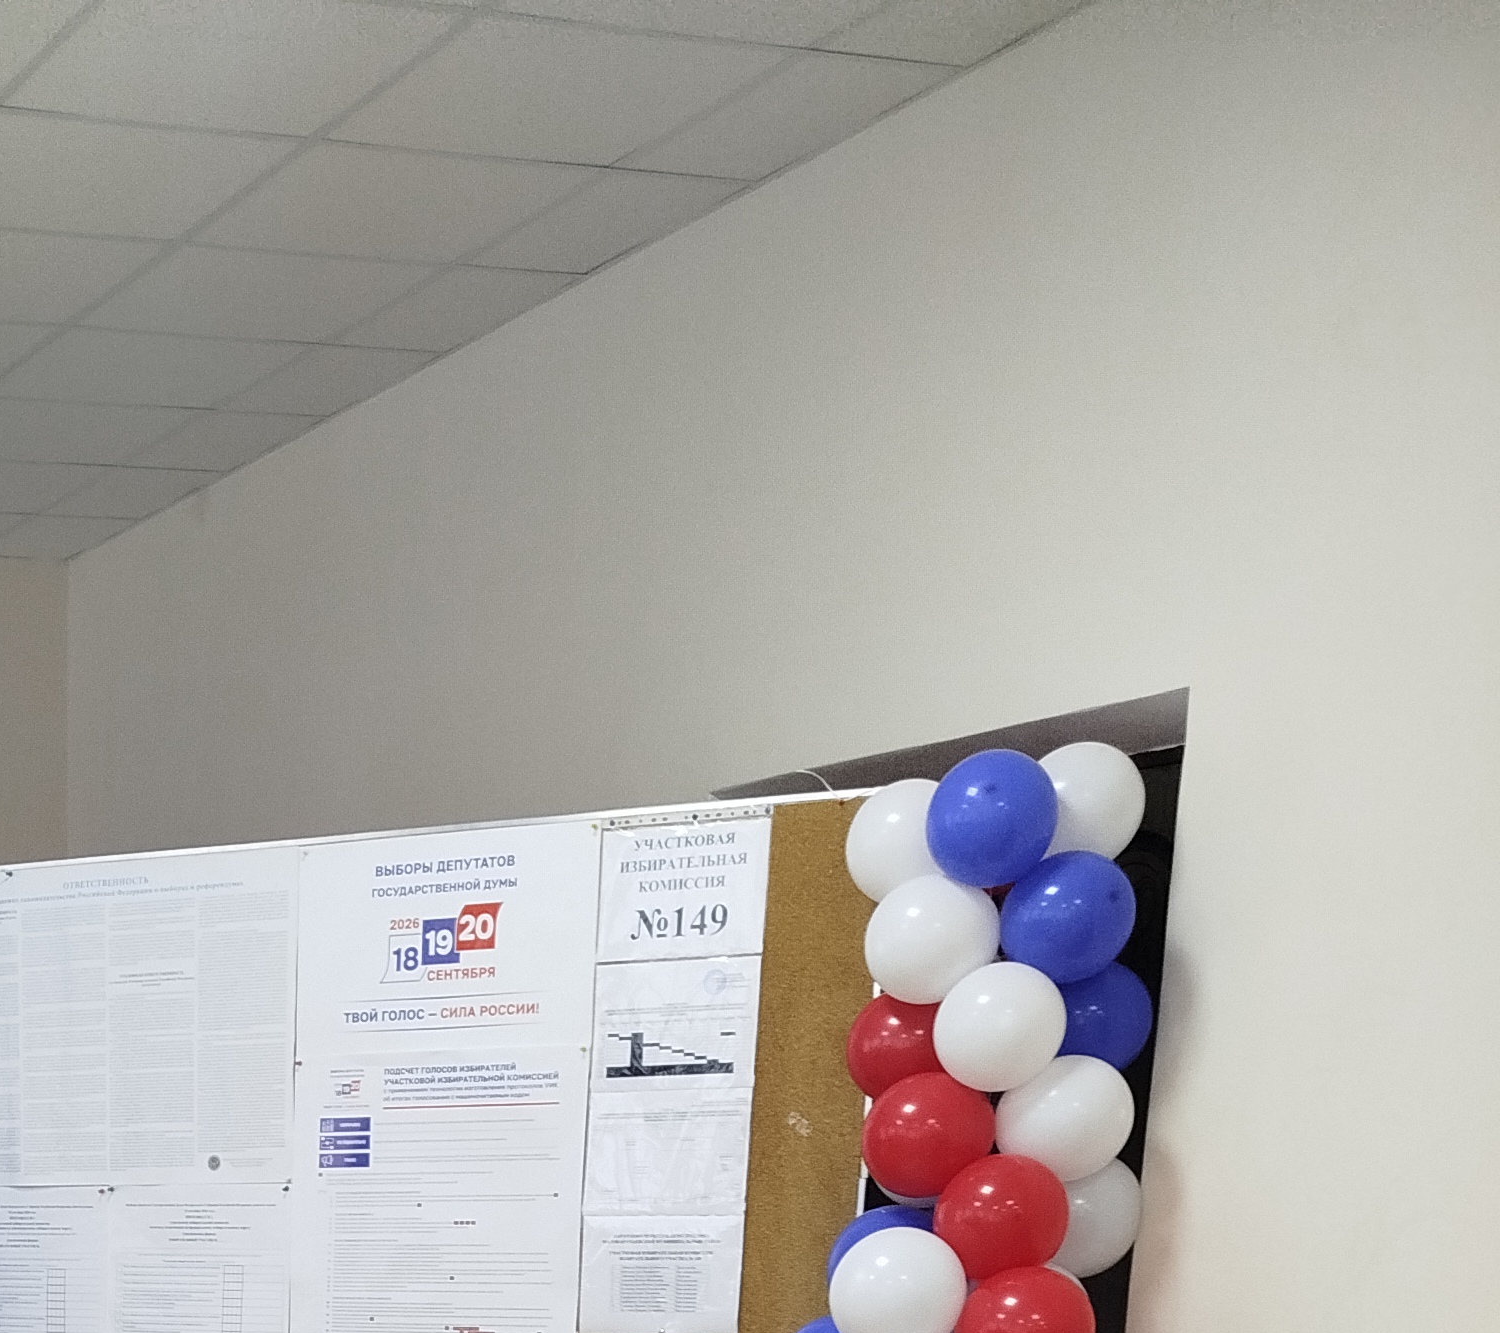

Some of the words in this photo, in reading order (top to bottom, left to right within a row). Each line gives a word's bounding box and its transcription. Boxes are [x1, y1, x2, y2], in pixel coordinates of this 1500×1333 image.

[634, 832, 736, 851] УЧАСТКОВАЯ
[375, 862, 433, 877] ВЫБОРЫ
[436, 854, 516, 873] ДЕПУТАТОВ
[620, 852, 748, 873] ИЗБИРАТЕЛЬНАЯ
[63, 876, 149, 889] ОТВЕТСТВЕННОСТЬ
[371, 879, 481, 898] ГОСУДАРСТВЕННОЙ
[483, 877, 518, 892] ДУМЫ
[638, 875, 726, 893] КОМИССИЯ
[389, 918, 420, 931] 2026
[630, 903, 728, 940] №149
[392, 946, 419, 972] 18
[425, 929, 453, 956] 19
[458, 913, 494, 942] 20
[426, 966, 496, 981] СЕНТЯБРЯ
[344, 1009, 378, 1024] ТВОЙ
[381, 1008, 425, 1022] ГОЛОС
[440, 1006, 476, 1019] СИЛА
[479, 1003, 540, 1016] РОССИИ!
[384, 1067, 419, 1076] ПОДСЧЕТ
[421, 1065, 458, 1074] ГОЛОСОВ
[459, 1061, 517, 1073] ИЗБИРАТЕЛЕЙ
[384, 1075, 436, 1086] УЧАСТКОВОЙ
[437, 1072, 505, 1084] ИЗБИРАТЕЛЬНОЙ
[506, 1070, 559, 1081] КОМИССИЕЙ
